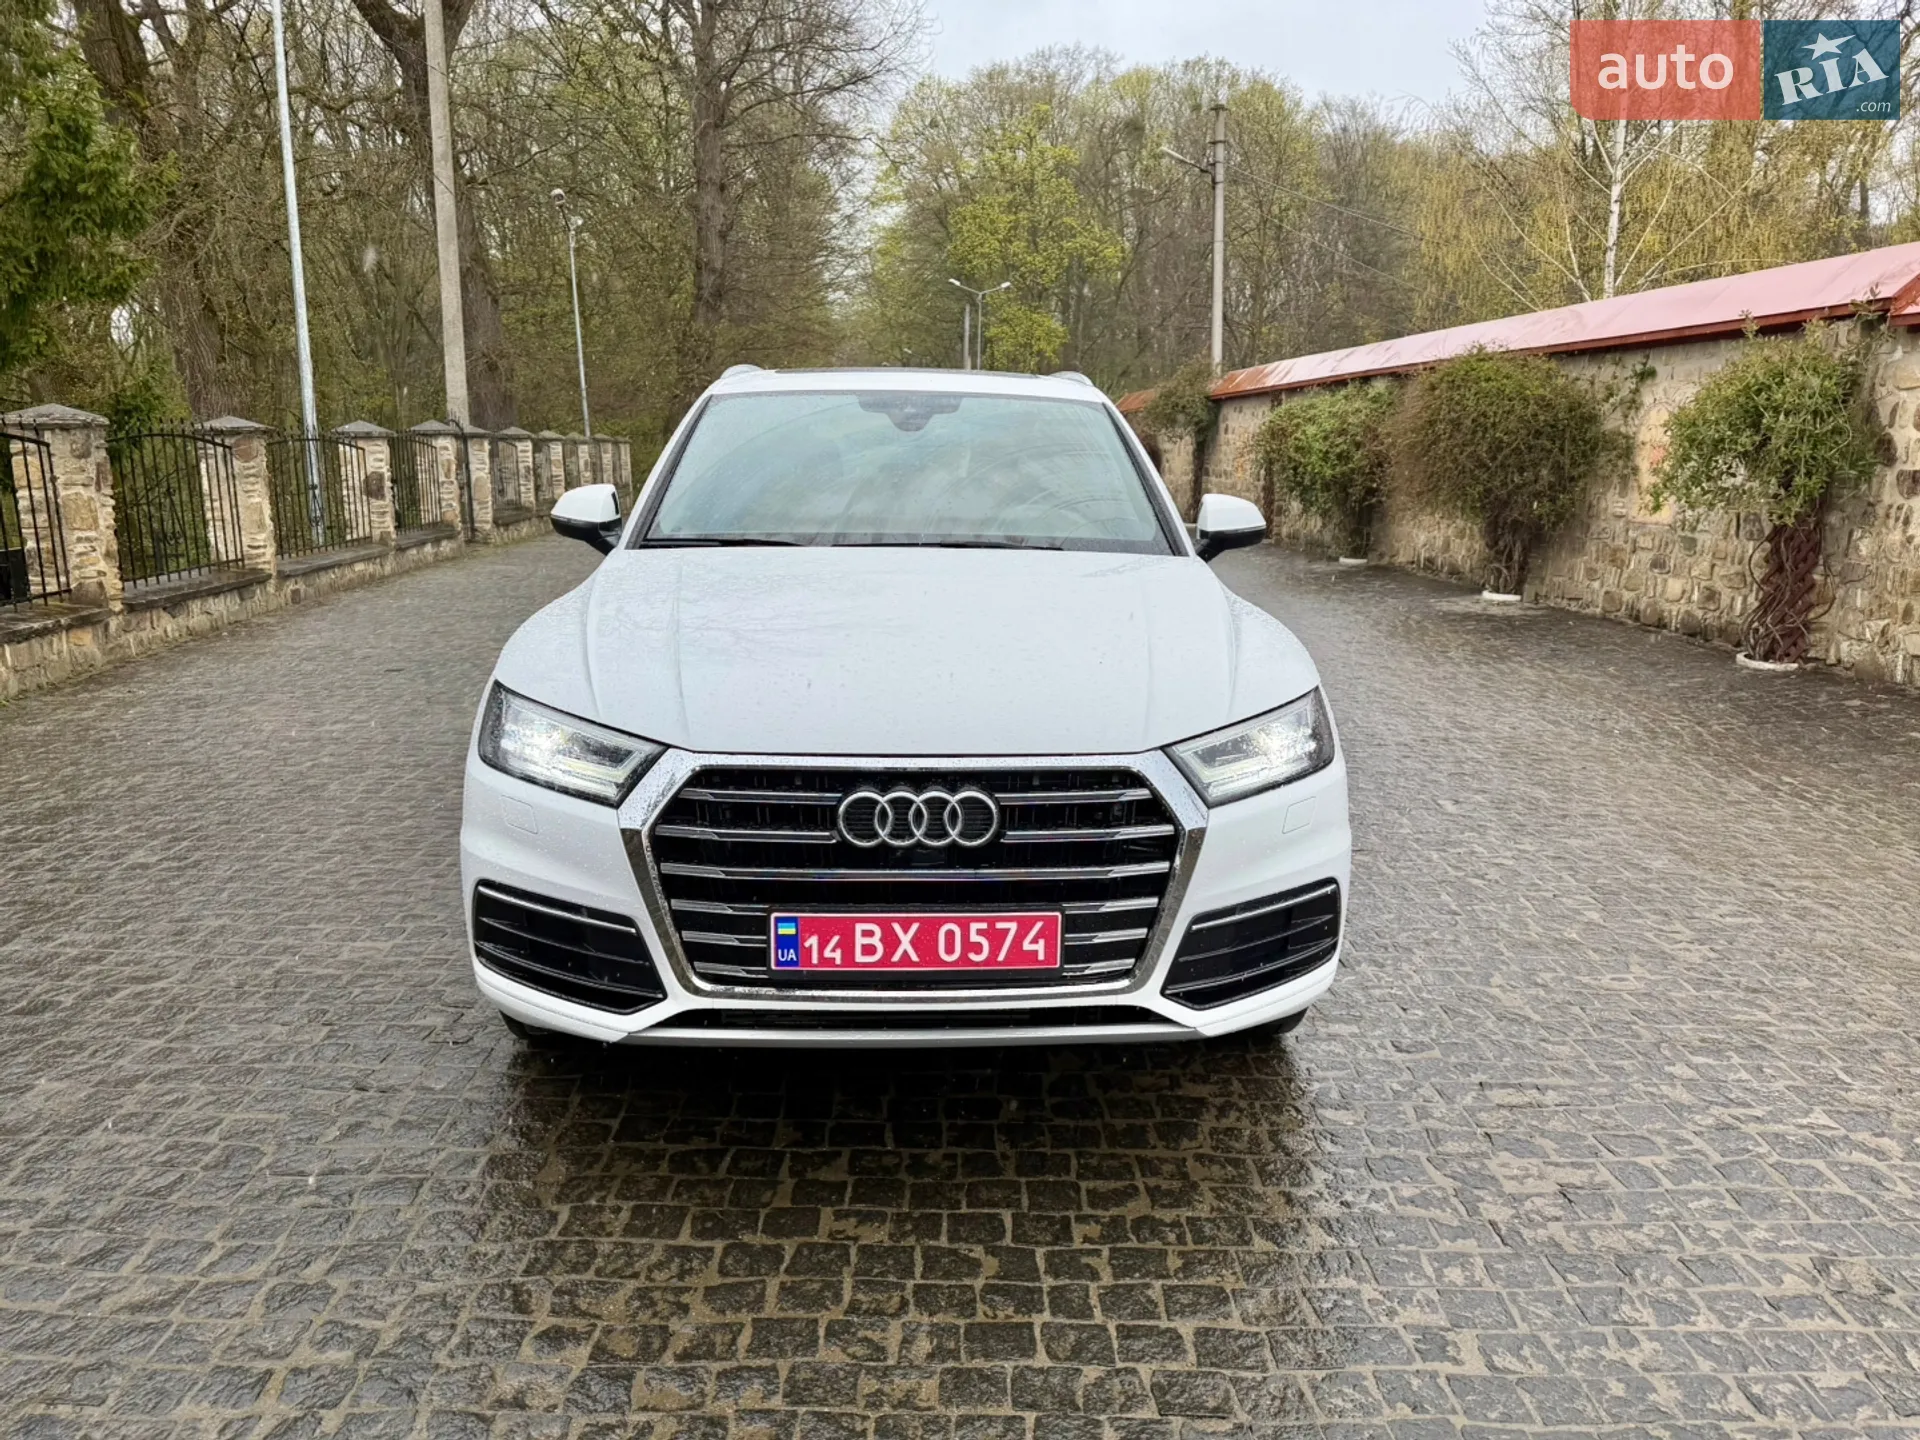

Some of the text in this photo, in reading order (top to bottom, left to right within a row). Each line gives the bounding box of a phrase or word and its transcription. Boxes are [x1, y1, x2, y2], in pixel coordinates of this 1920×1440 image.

[777, 948, 797, 961] UA
[803, 921, 1045, 965] 14 BX 0574
